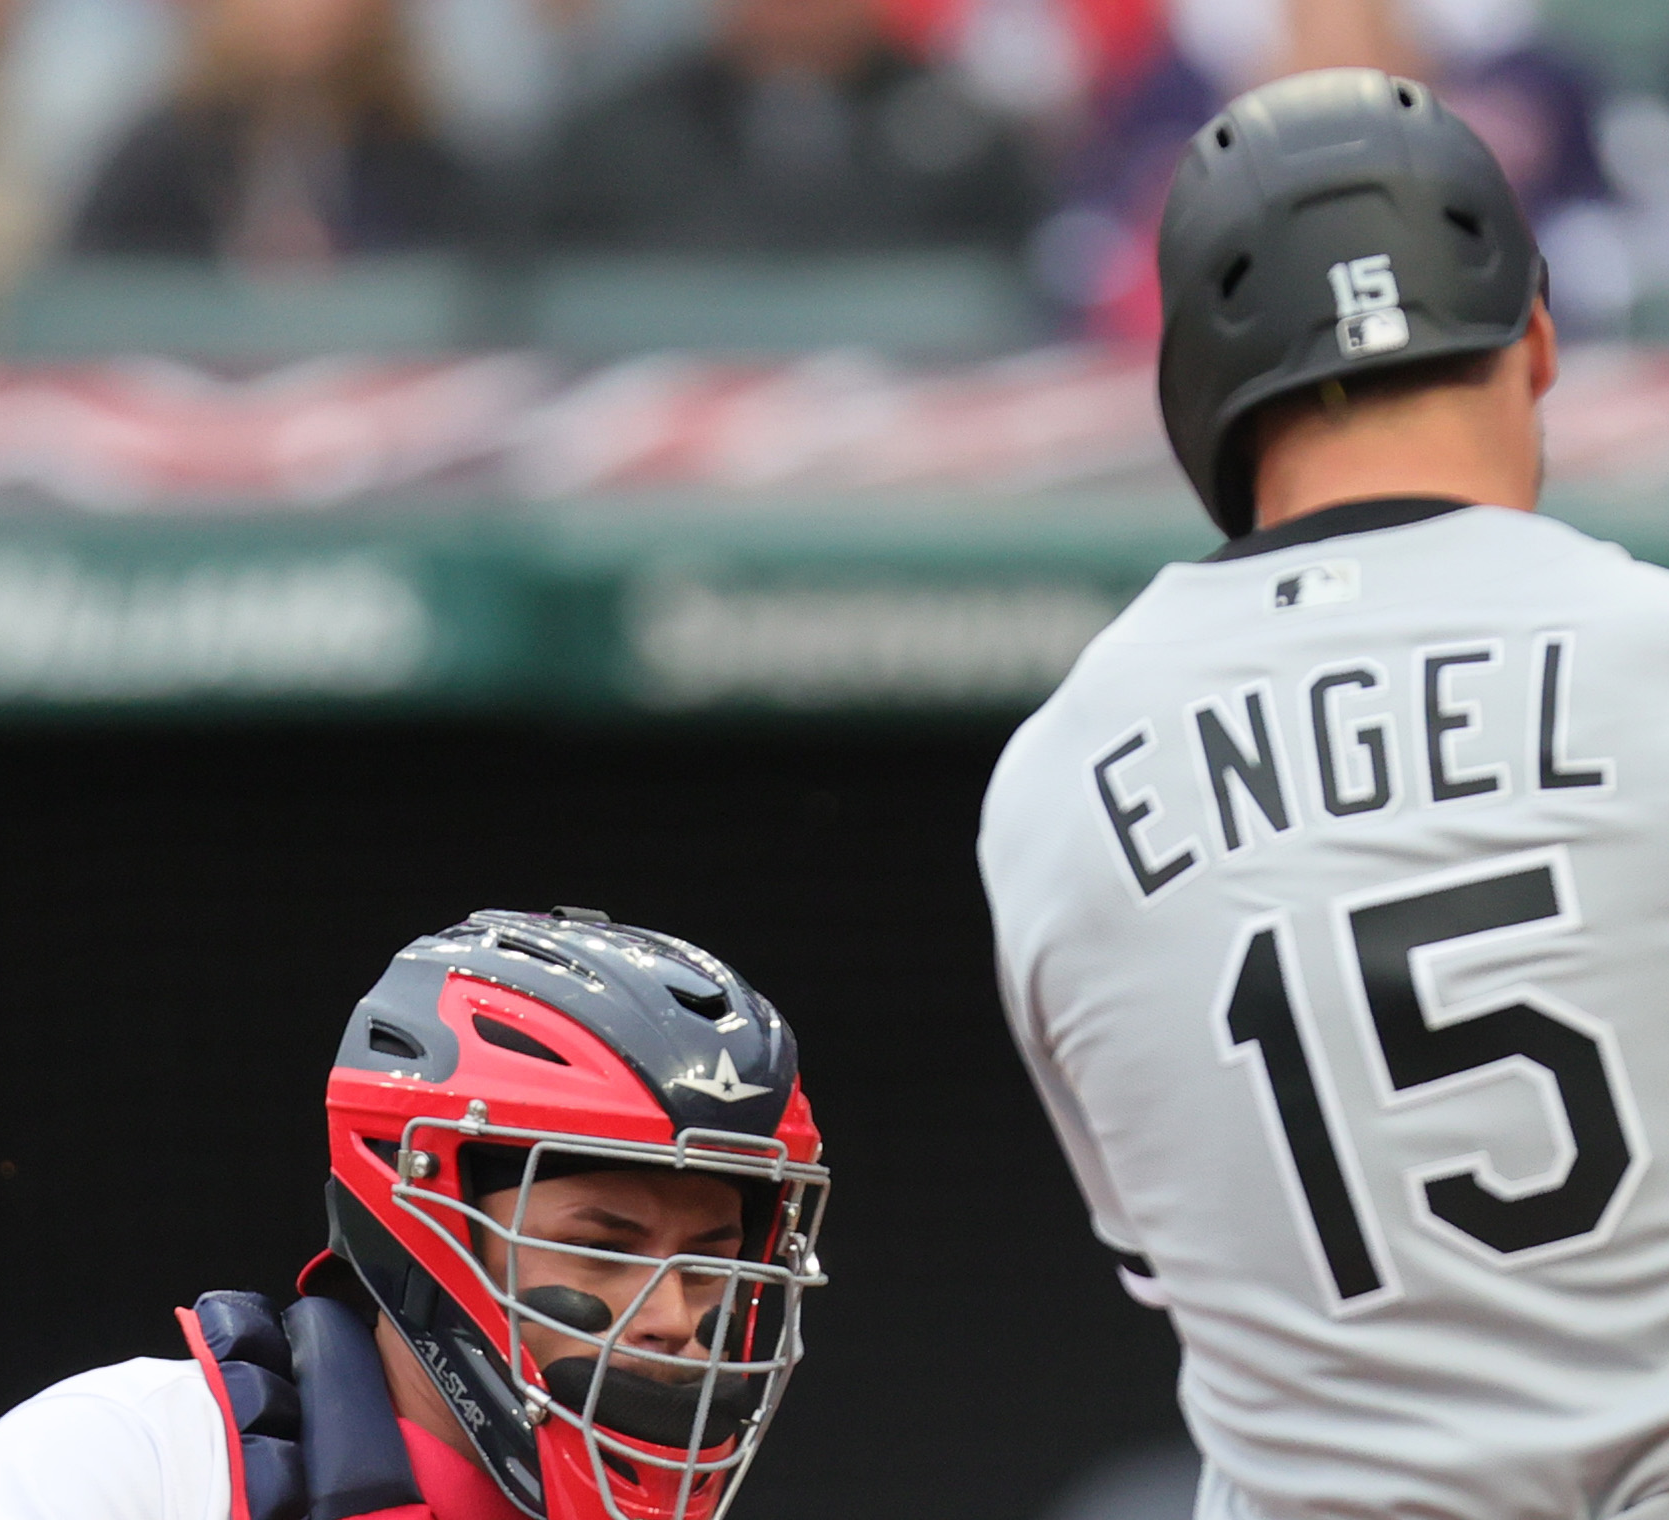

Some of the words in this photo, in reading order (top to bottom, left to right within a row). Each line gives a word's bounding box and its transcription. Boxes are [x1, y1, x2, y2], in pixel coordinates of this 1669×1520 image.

[1327, 253, 1399, 319] 15
[1091, 636, 1613, 900] ENGEL
[1219, 856, 1643, 1310] 15
